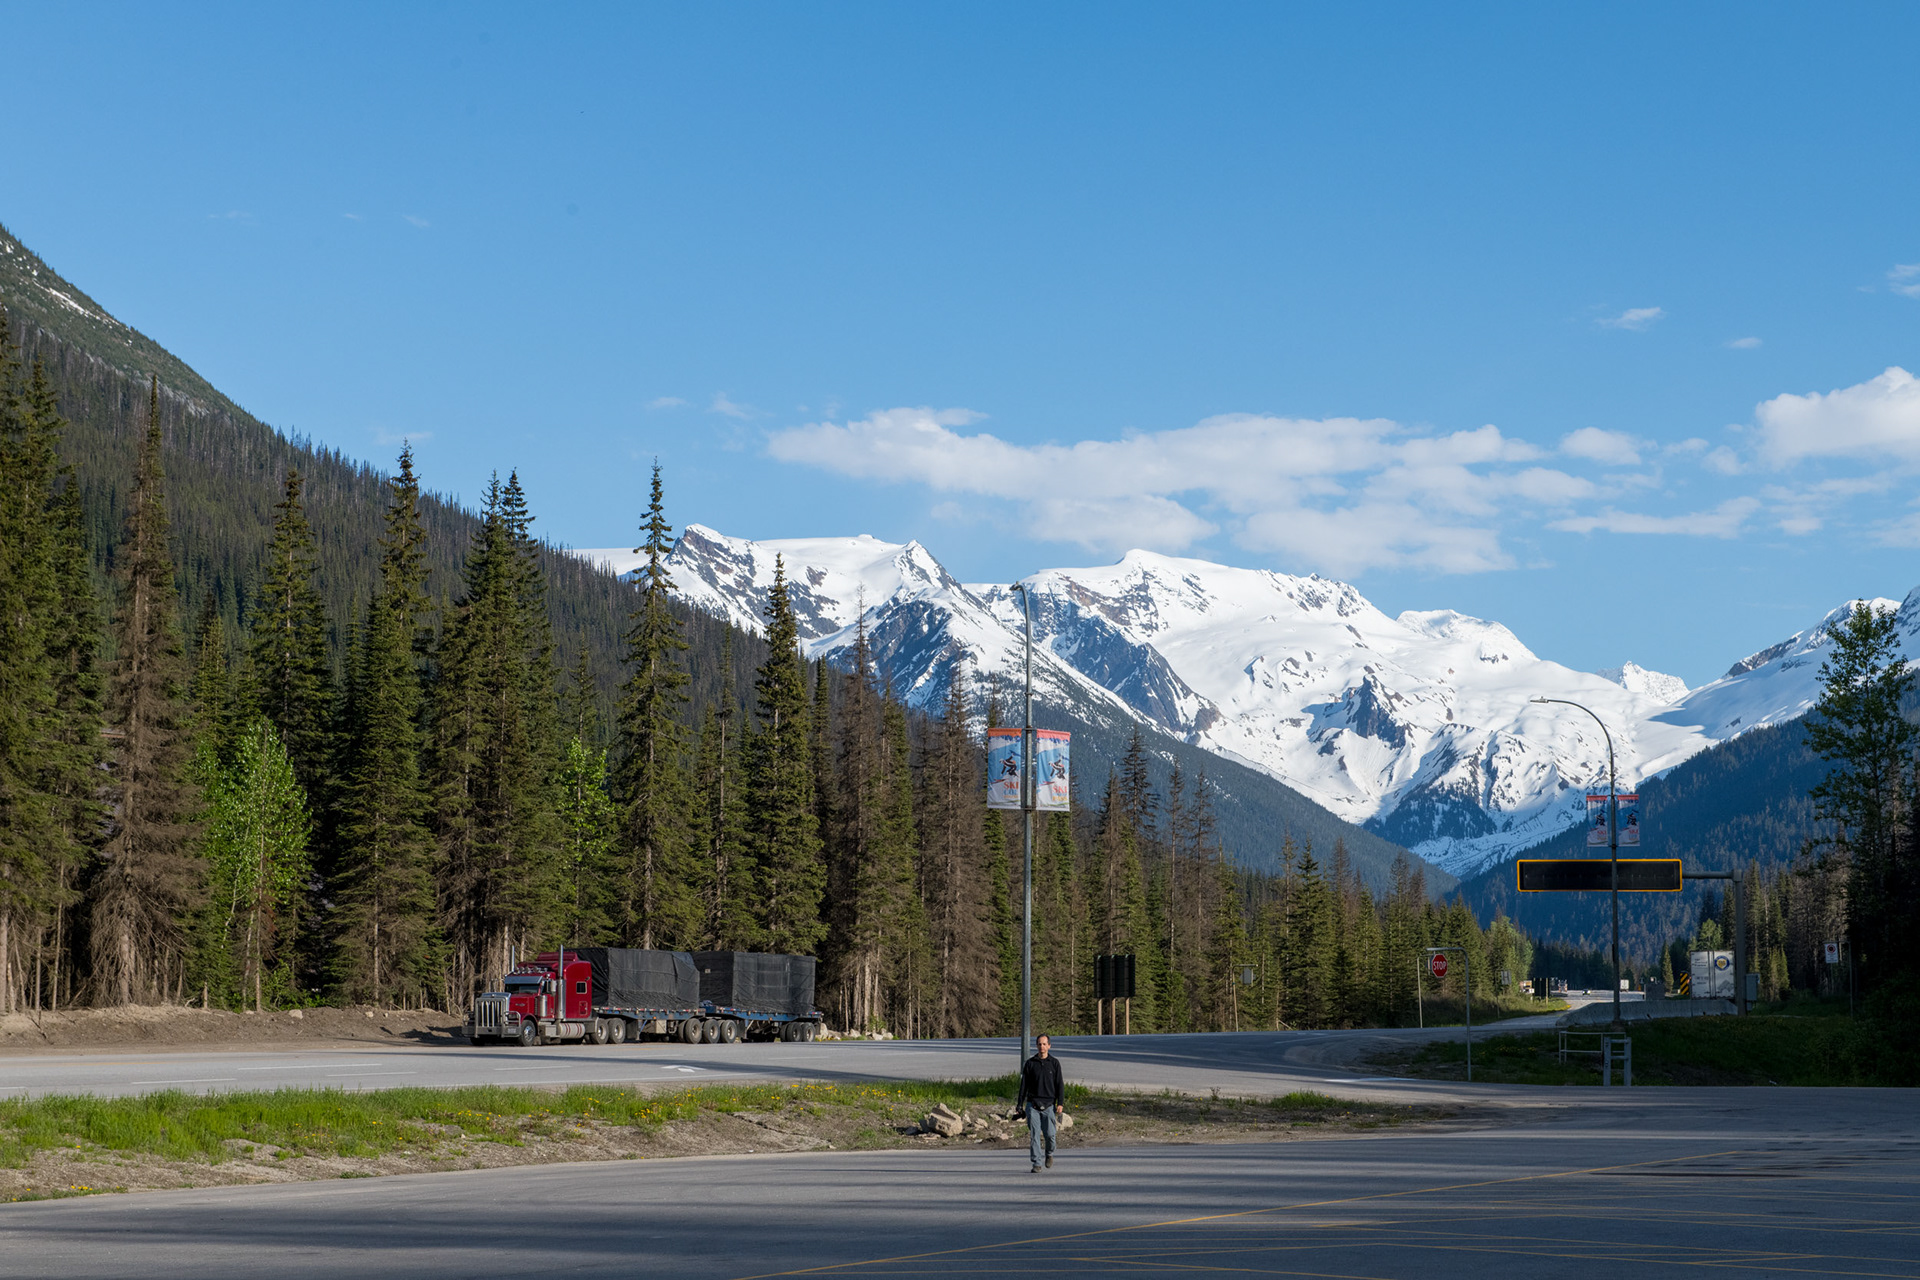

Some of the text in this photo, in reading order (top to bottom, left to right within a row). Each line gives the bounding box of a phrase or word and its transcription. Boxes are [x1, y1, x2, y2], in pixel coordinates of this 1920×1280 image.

[1003, 781, 1019, 789] SKI
[1053, 785, 1067, 793] SKI
[1433, 961, 1446, 970] STOP
